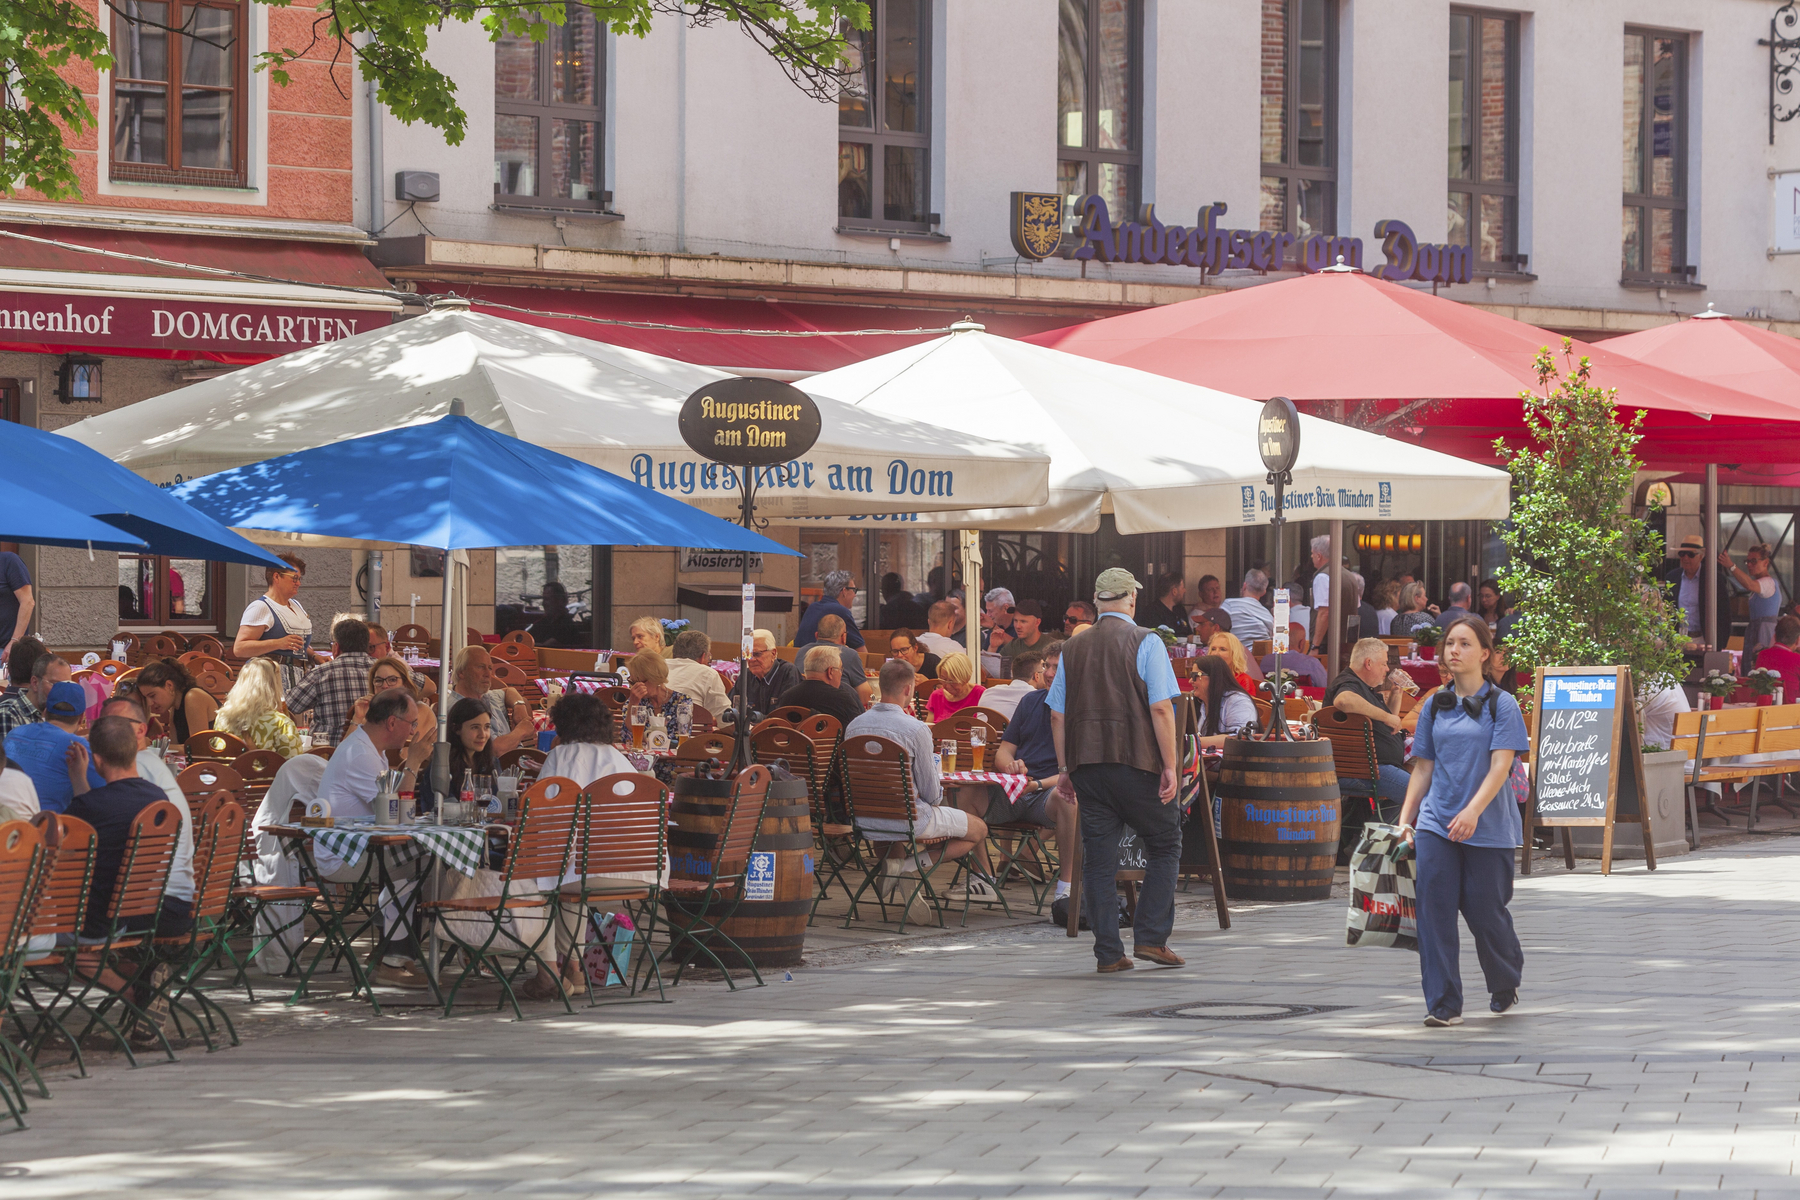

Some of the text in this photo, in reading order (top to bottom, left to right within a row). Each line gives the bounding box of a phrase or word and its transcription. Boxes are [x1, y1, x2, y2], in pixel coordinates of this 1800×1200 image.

[1064, 194, 1473, 284] Andechser am Dom
[151, 309, 357, 344] DOMGARTEN
[701, 395, 802, 423] Augustiner
[714, 424, 787, 448] am Dom
[827, 463, 874, 492] am
[887, 459, 954, 497] Dom
[1337, 488, 1374, 509] München
[687, 554, 761, 568] Klosterber
[1545, 710, 1566, 731] Ab
[1276, 827, 1316, 841] München
